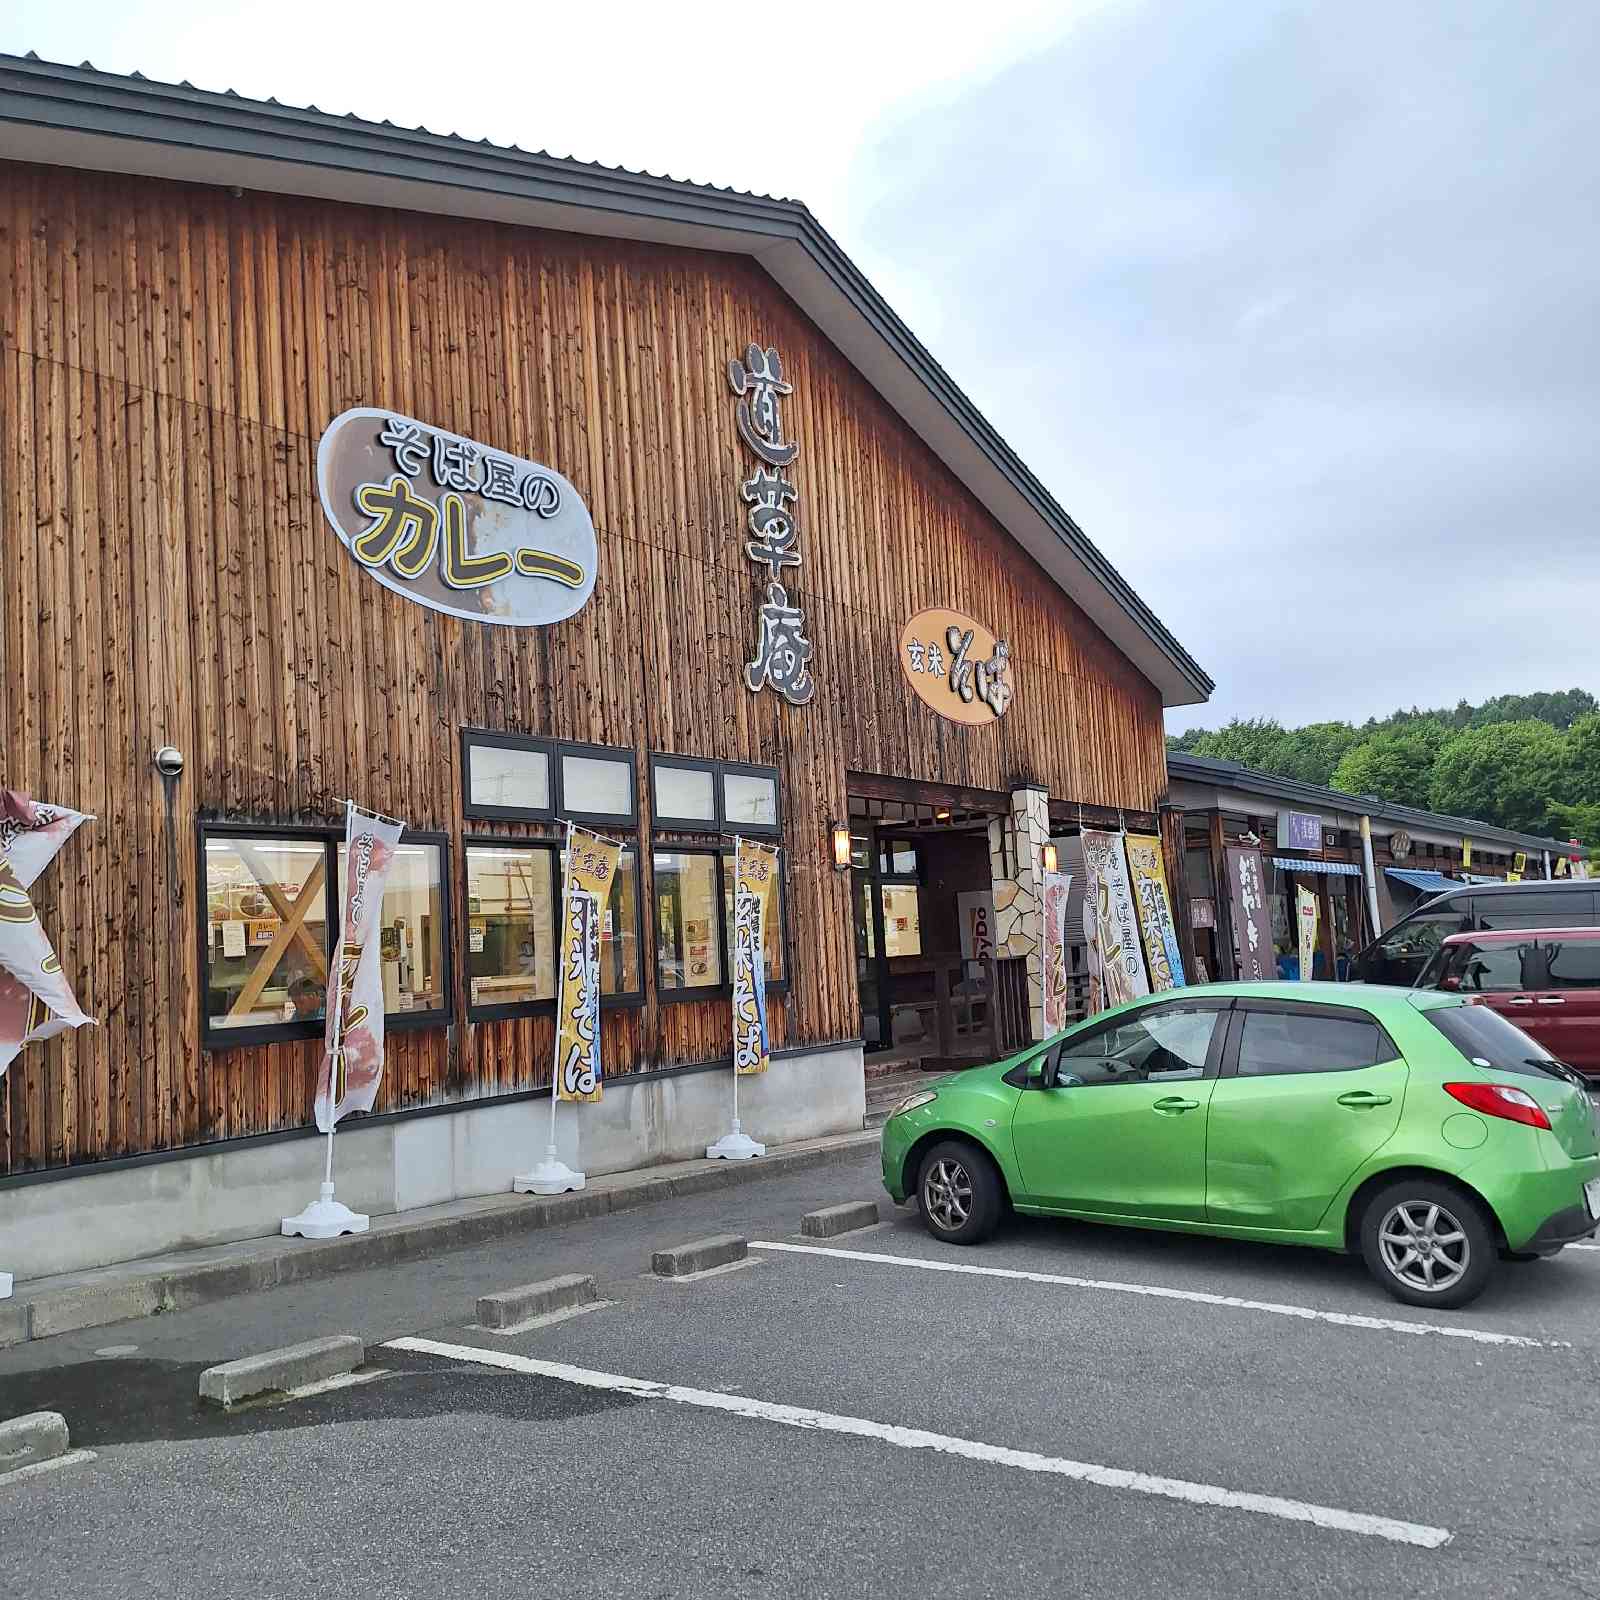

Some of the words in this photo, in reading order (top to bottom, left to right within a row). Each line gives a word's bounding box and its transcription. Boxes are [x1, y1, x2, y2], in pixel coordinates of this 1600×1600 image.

[380, 417, 562, 518] そば屋の
[353, 476, 586, 589] カレー
[906, 637, 946, 679] 玄米
